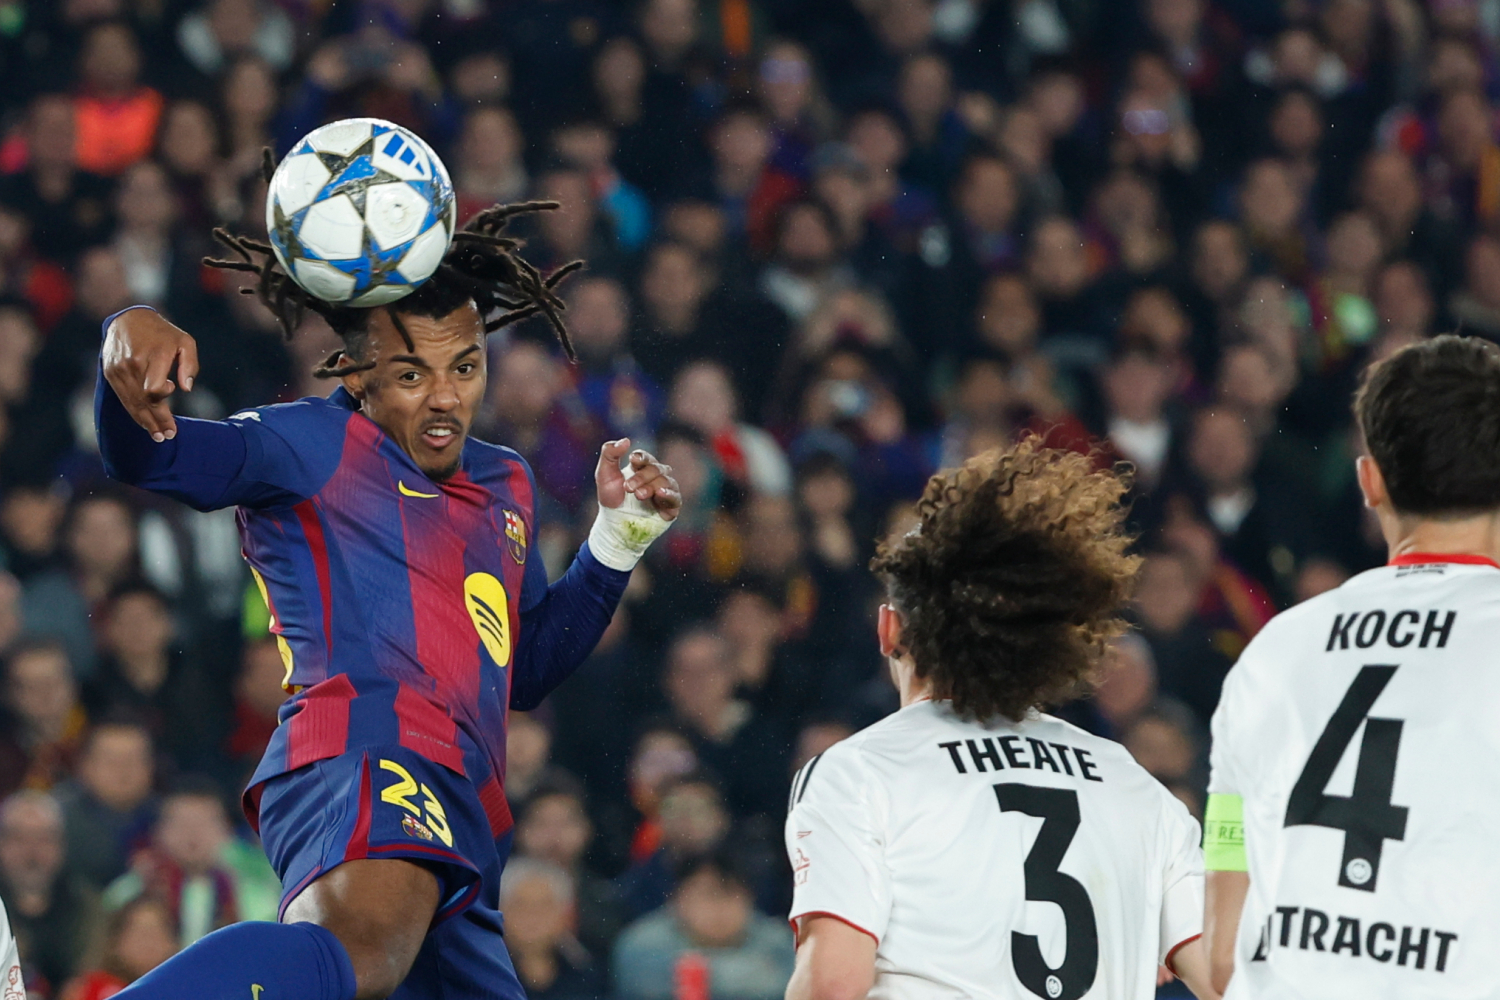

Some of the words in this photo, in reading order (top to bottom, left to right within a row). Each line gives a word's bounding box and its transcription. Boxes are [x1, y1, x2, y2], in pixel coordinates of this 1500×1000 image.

[1325, 609, 1457, 652] KOCH
[937, 735, 1104, 783] THEATE
[1283, 663, 1410, 892] 4
[379, 758, 454, 848] 23
